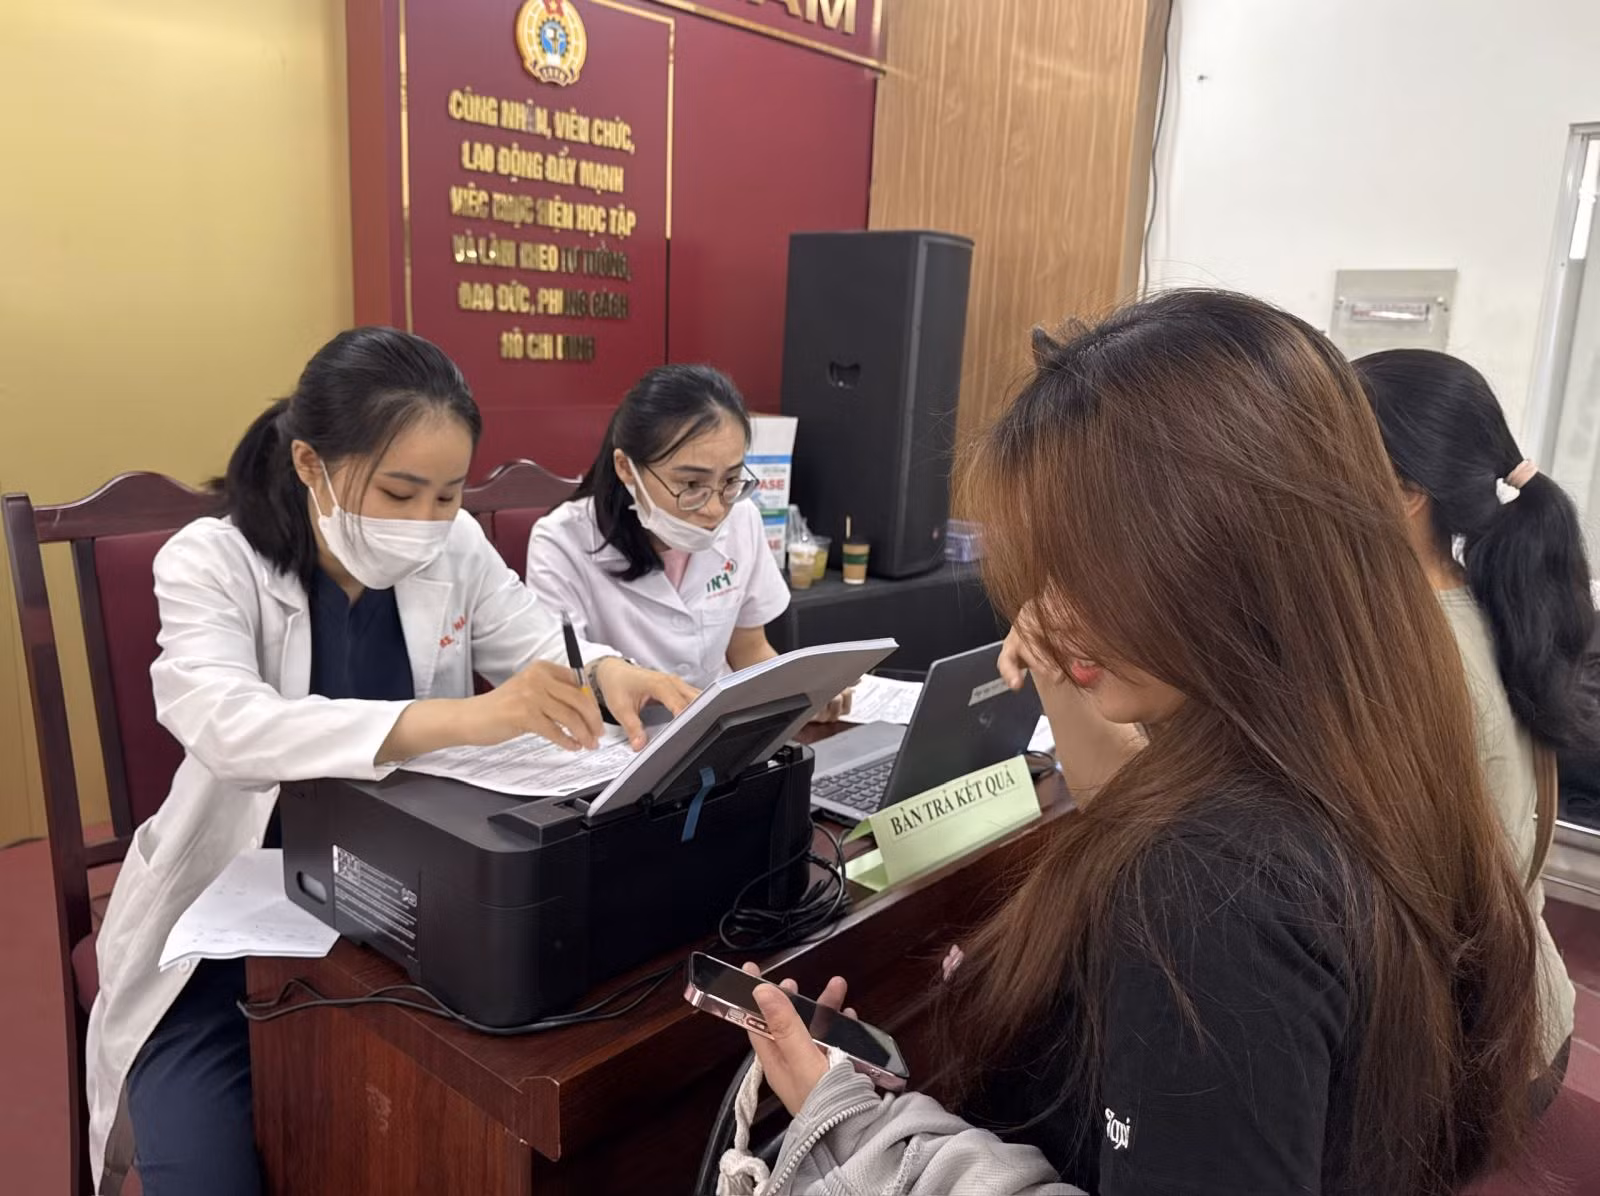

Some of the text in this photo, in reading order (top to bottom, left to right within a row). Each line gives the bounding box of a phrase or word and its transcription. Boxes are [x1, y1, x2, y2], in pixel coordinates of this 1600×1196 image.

[449, 86, 498, 125] CÔNG
[554, 107, 589, 143] VIÊN
[461, 141, 624, 194] LAO ĐỘNG ĐẨY MẠNH
[576, 202, 607, 238] HỌC
[609, 203, 636, 240] TẬP
[890, 764, 1016, 836] BÀN TRẢ KẾT QUẢ
